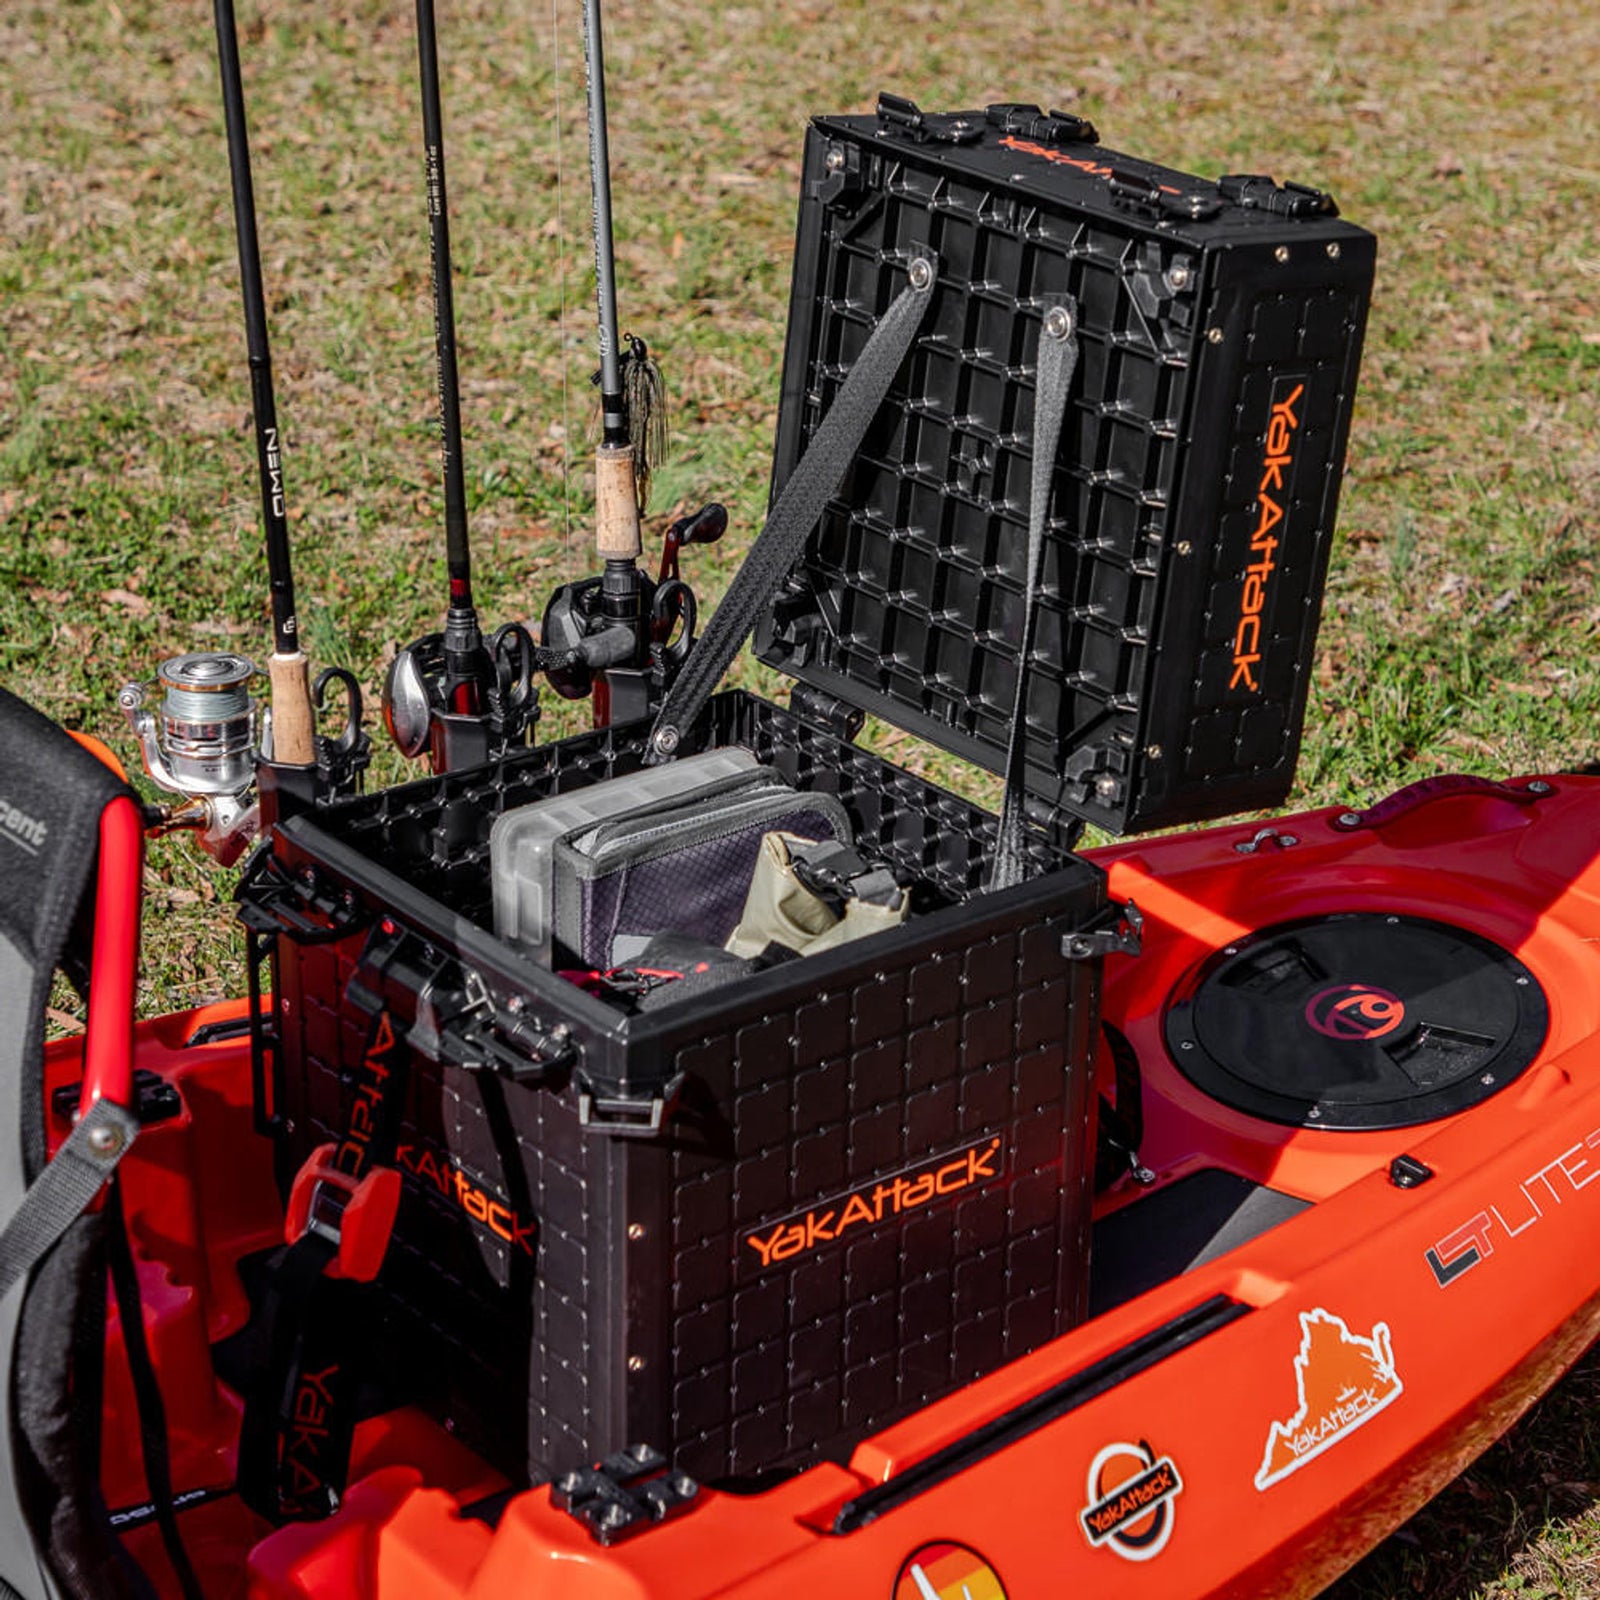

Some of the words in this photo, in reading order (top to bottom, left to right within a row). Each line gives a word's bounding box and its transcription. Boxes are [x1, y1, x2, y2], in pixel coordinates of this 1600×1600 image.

[264, 428, 284, 517] OMEN
[1230, 384, 1304, 692] YakAttack
[747, 1137, 1001, 1267] YakAttack
[1283, 1387, 1380, 1457] YakAttack
[1088, 1465, 1173, 1533] YakAttack
